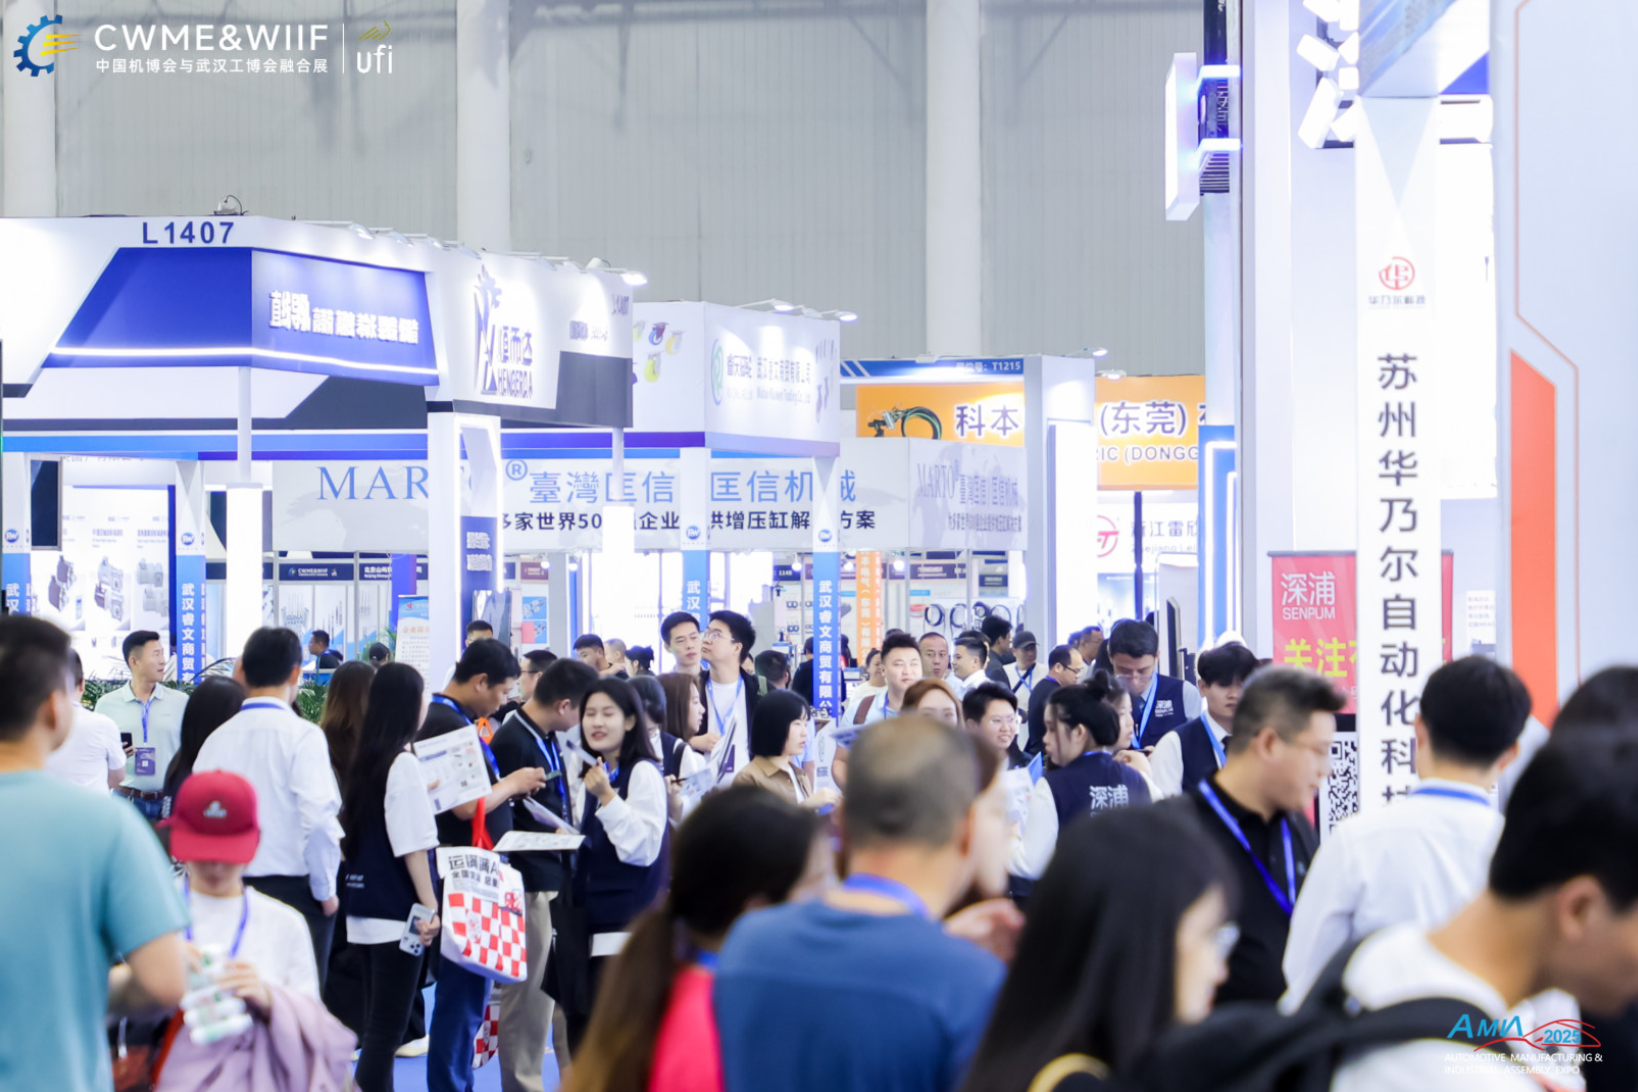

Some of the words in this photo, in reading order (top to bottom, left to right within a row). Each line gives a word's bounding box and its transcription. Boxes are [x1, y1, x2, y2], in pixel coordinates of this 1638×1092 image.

[142, 222, 234, 244] L1407
[992, 362, 1021, 371] T1215
[956, 404, 1020, 436] 科本
[1096, 447, 1118, 460] IC
[1281, 571, 1335, 605] 深浦
[1282, 607, 1335, 620] SENPUM
[1089, 784, 1129, 809] 深浦
